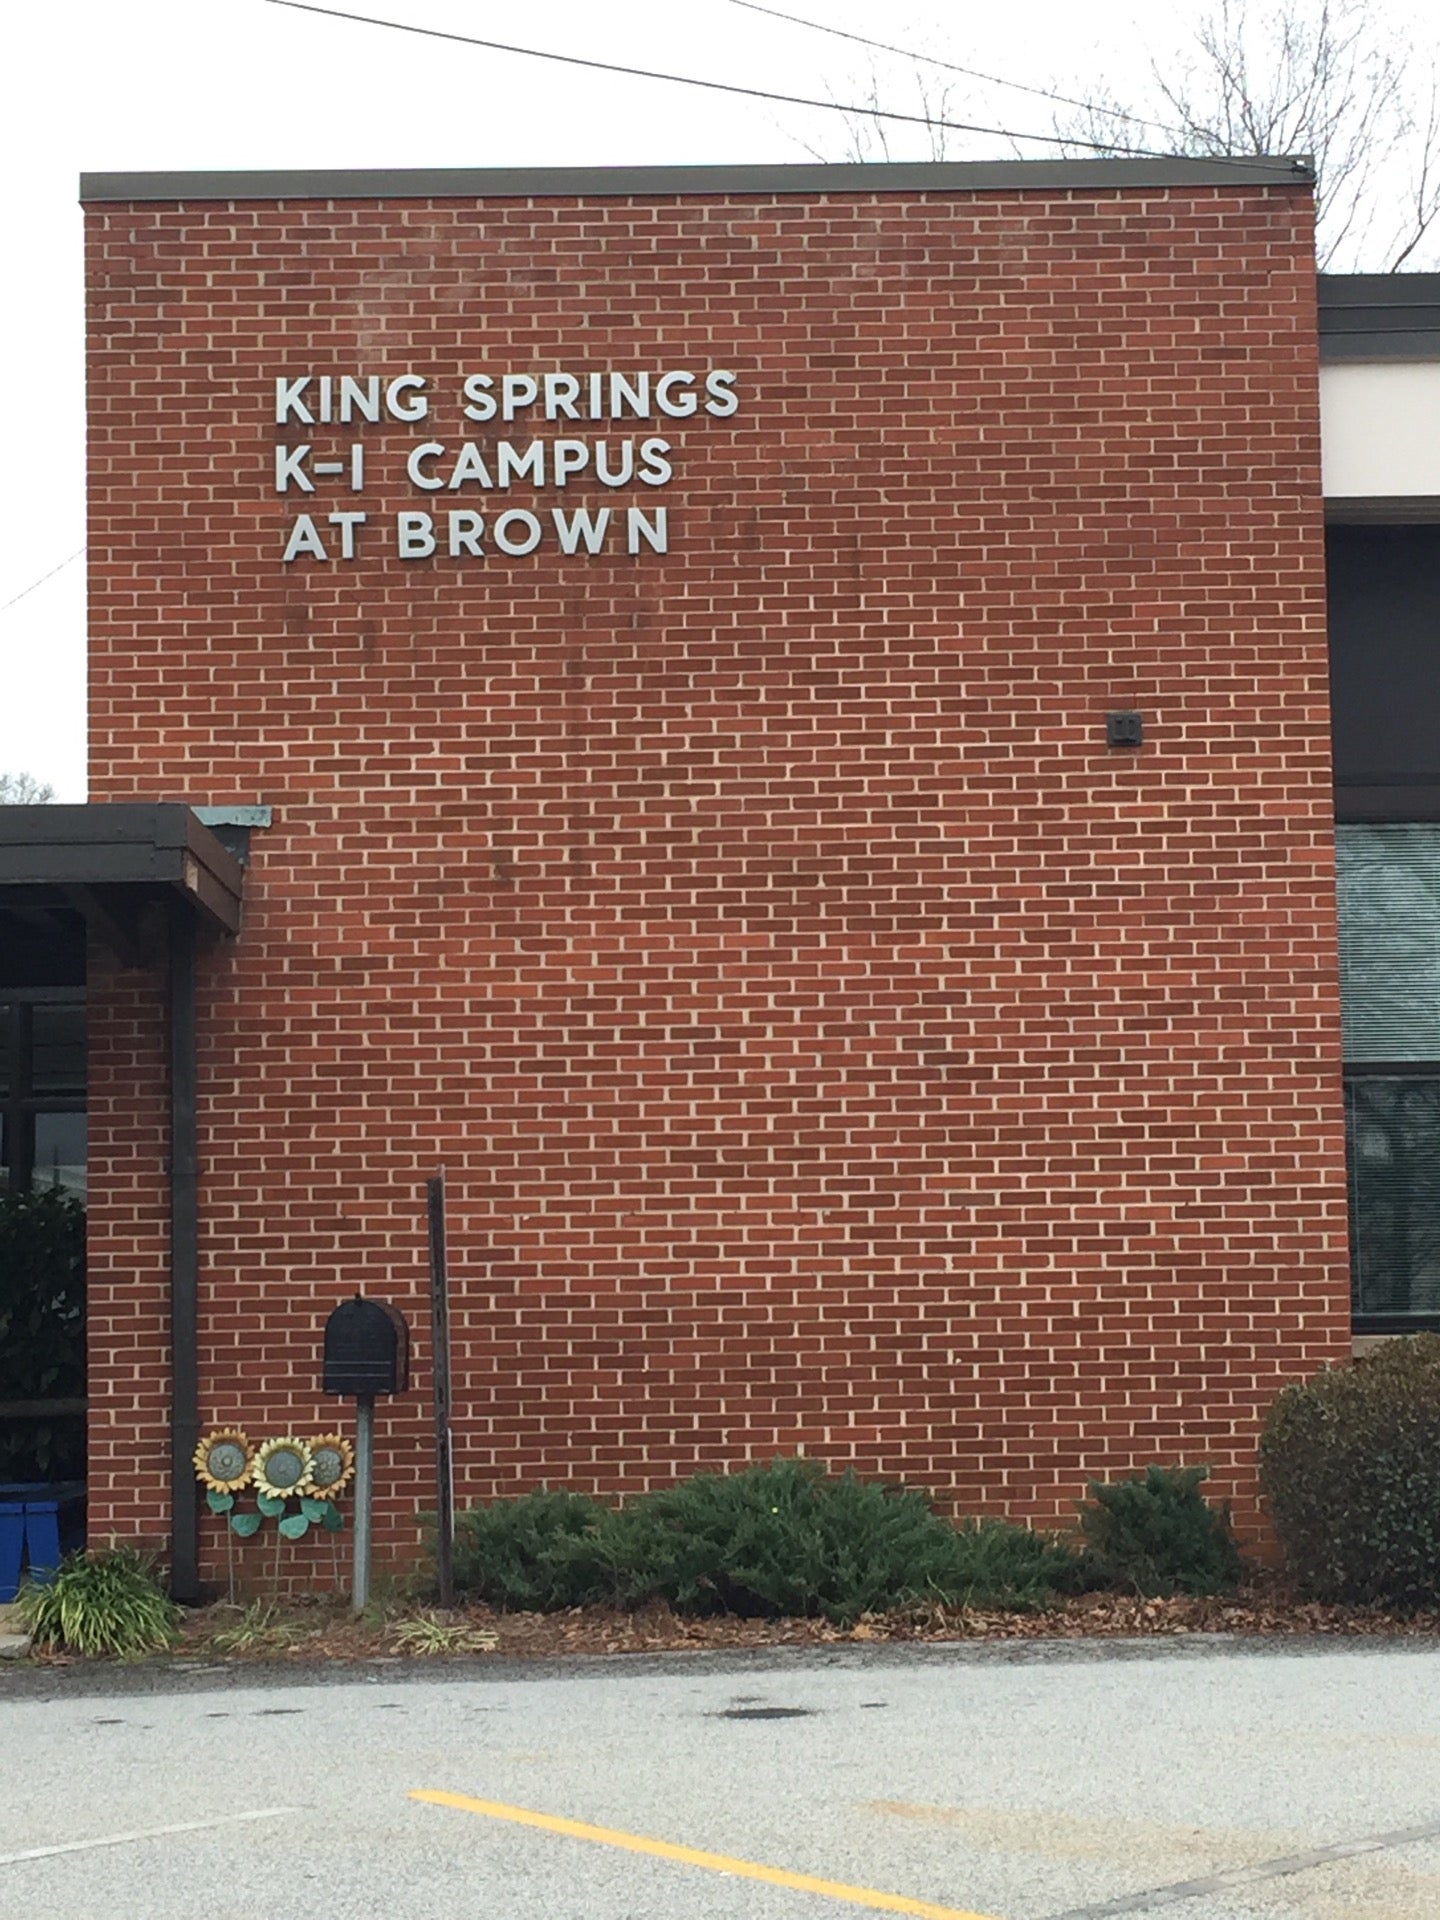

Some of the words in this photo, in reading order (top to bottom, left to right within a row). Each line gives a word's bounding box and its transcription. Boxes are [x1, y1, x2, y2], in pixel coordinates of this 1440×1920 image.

[276, 374, 428, 424] KING
[463, 369, 738, 421] SPRINGS
[407, 438, 672, 490] CAMPUS
[283, 511, 366, 561] AT
[398, 507, 667, 558] BROWN
